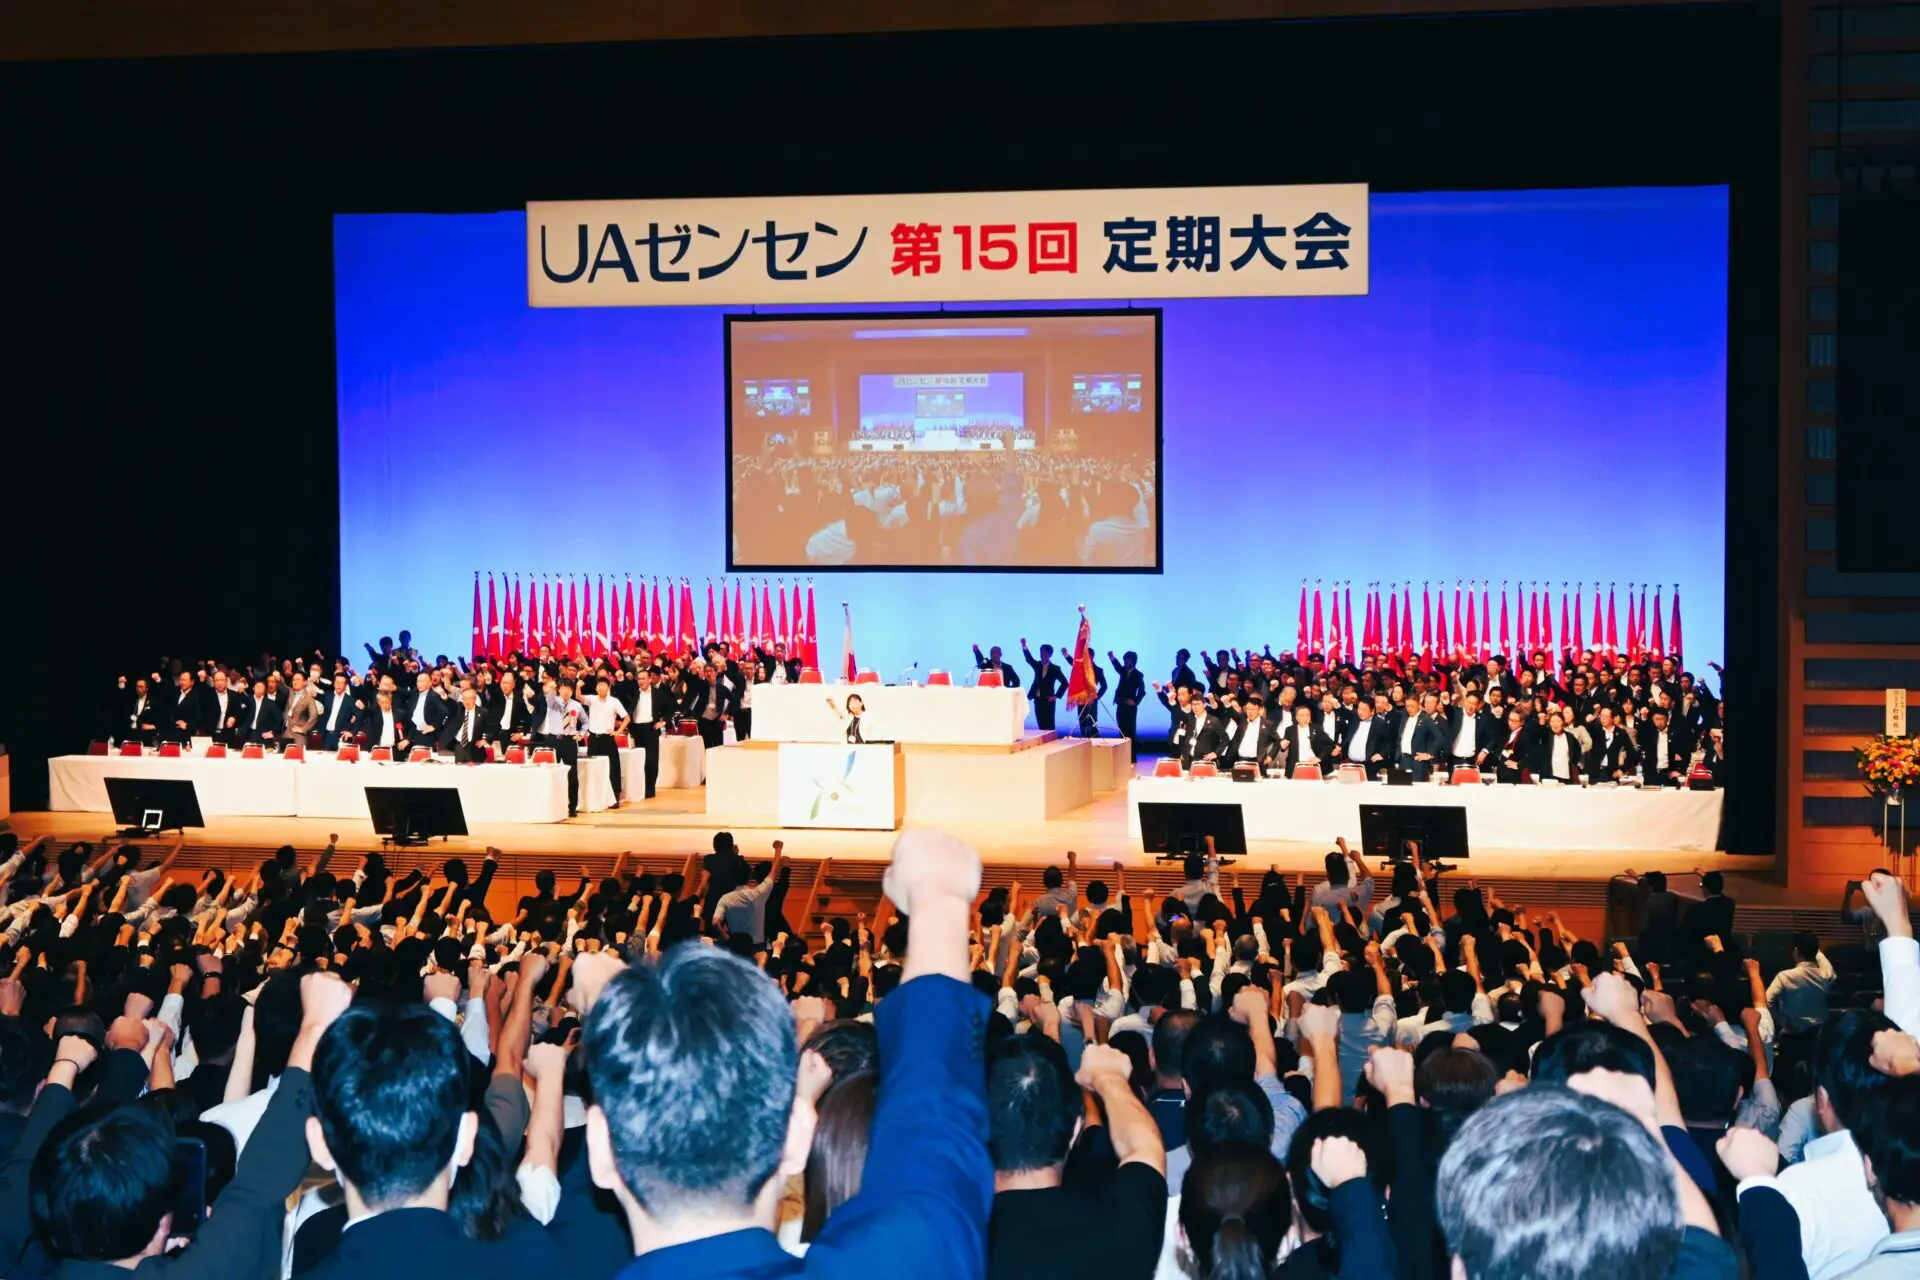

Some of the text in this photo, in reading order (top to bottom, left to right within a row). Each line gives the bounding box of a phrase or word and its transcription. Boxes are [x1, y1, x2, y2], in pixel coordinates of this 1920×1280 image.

[541, 212, 1352, 284] UAゼンセン 第15回 定期大会
